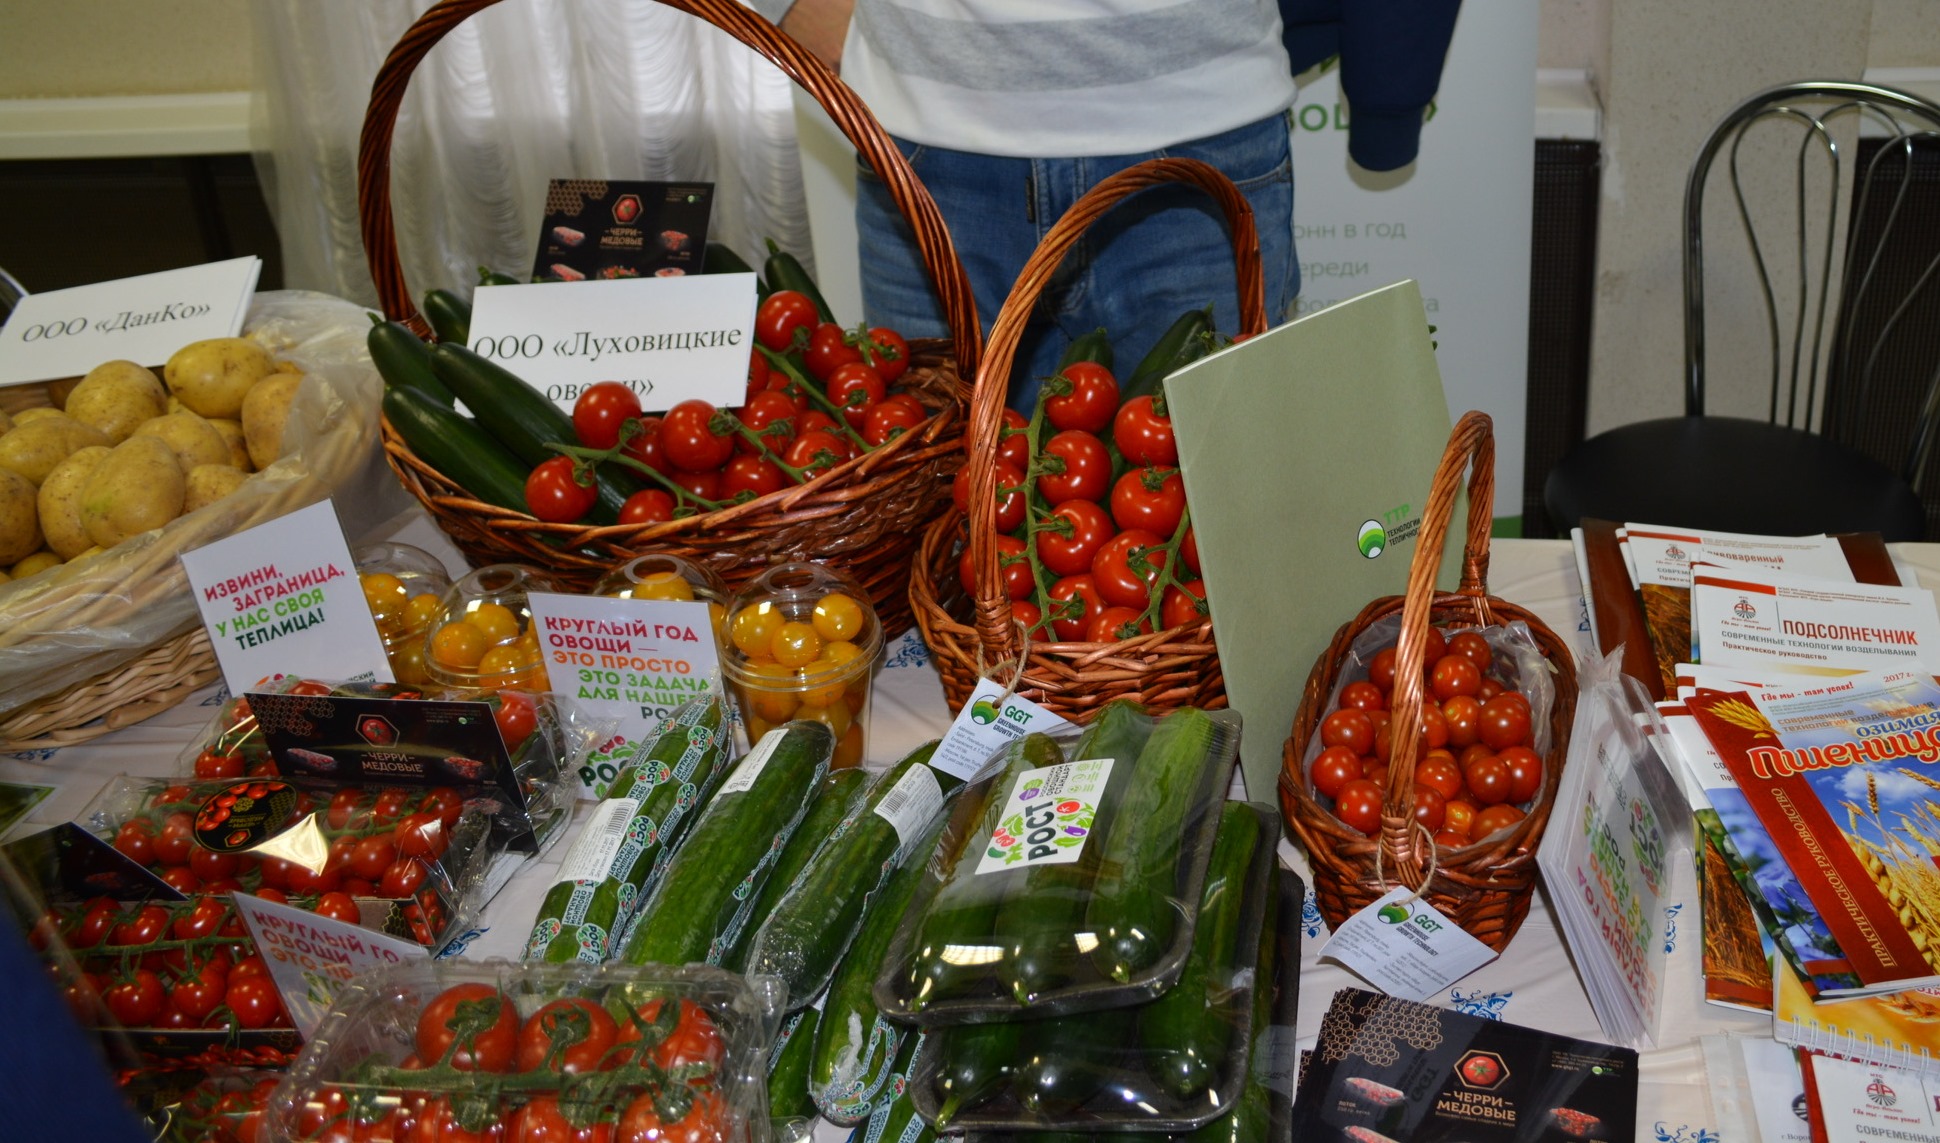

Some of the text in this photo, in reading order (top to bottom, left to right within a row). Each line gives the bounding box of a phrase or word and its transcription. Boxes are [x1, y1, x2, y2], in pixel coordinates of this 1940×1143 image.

[1293, 224, 1335, 239] онн
[1366, 223, 1407, 239] год
[22, 302, 212, 342] ООО «ДанКо»
[474, 328, 742, 361] ООО «Луховицкие
[204, 564, 283, 602] ИЗВИНИ,
[232, 563, 345, 612] ЗАГРАНИЦА,
[215, 588, 325, 637] У НАС СВОЯ
[235, 608, 325, 650] ТЕПЛИЦА!
[545, 616, 699, 642] КРУГЛЫЙ ГОД
[1783, 619, 1918, 646] ПОДСОЛНЕЧНИК
[549, 634, 631, 653] ОВОЩИ
[1721, 630, 1917, 657] СОВРЕМЕННЫЕ ТЕХНОЛОГИИ ВОЗДЕЛЫВАНИЯ
[1778, 650, 1827, 660] руководство
[553, 651, 691, 674] ЭТО ПРОСТО
[578, 669, 709, 692] ЭТО ЗАДАЧА
[1826, 682, 1854, 695] успех!
[1883, 672, 1905, 683] 2017
[577, 685, 619, 701] ДЛЯ
[997, 718, 1026, 735] GREENHOUSE
[1004, 705, 1033, 725] GGT
[1778, 709, 1855, 725] современные
[1782, 718, 1848, 732] технологии
[1850, 701, 1935, 723] возделывания
[362, 761, 423, 772] МЕДОВЫЕ
[369, 752, 407, 762] ЧЕРРИ
[646, 761, 659, 785] РОСТ
[635, 817, 649, 847] РОСТ
[1025, 801, 1058, 861] РОСТ
[1770, 787, 1827, 868] РУКОВОДСТВО
[1414, 914, 1443, 933] GGT
[1824, 867, 1896, 968] ПРАКТИЧЕСКОЕ
[252, 910, 399, 963] КРУГЛЫЙ ГО
[261, 928, 352, 966] ОВОЩИ
[588, 924, 601, 955] РОСТ
[271, 947, 317, 971] ЭТО
[1436, 1099, 1516, 1121] МЕДОВЫЕ
[1453, 1090, 1503, 1107] ЧЕРРИ
